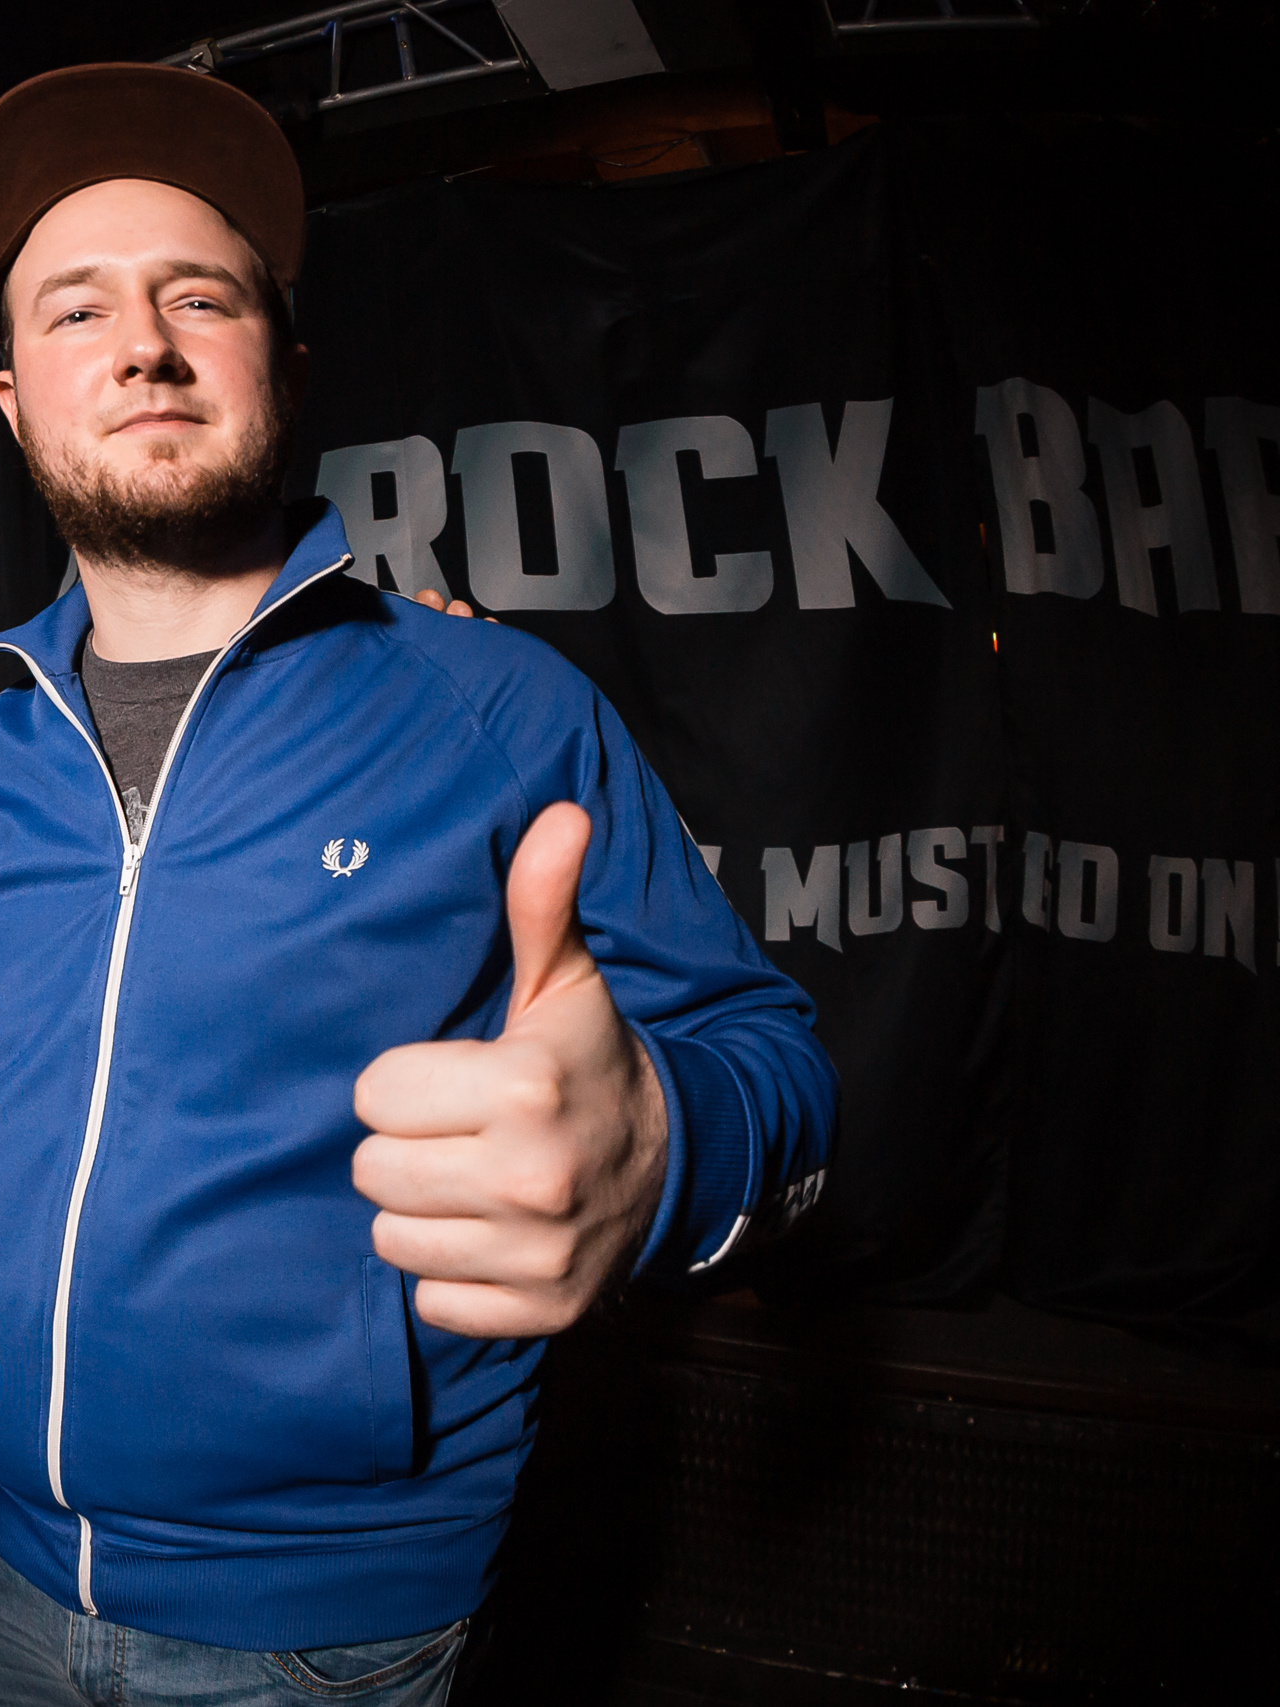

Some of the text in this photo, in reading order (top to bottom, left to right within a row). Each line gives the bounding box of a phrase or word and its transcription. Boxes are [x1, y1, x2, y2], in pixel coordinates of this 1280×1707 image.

[314, 396, 954, 616] ROCK
[760, 825, 1005, 954] MUST
[1022, 829, 1120, 943] GO
[1147, 854, 1259, 977] ON
